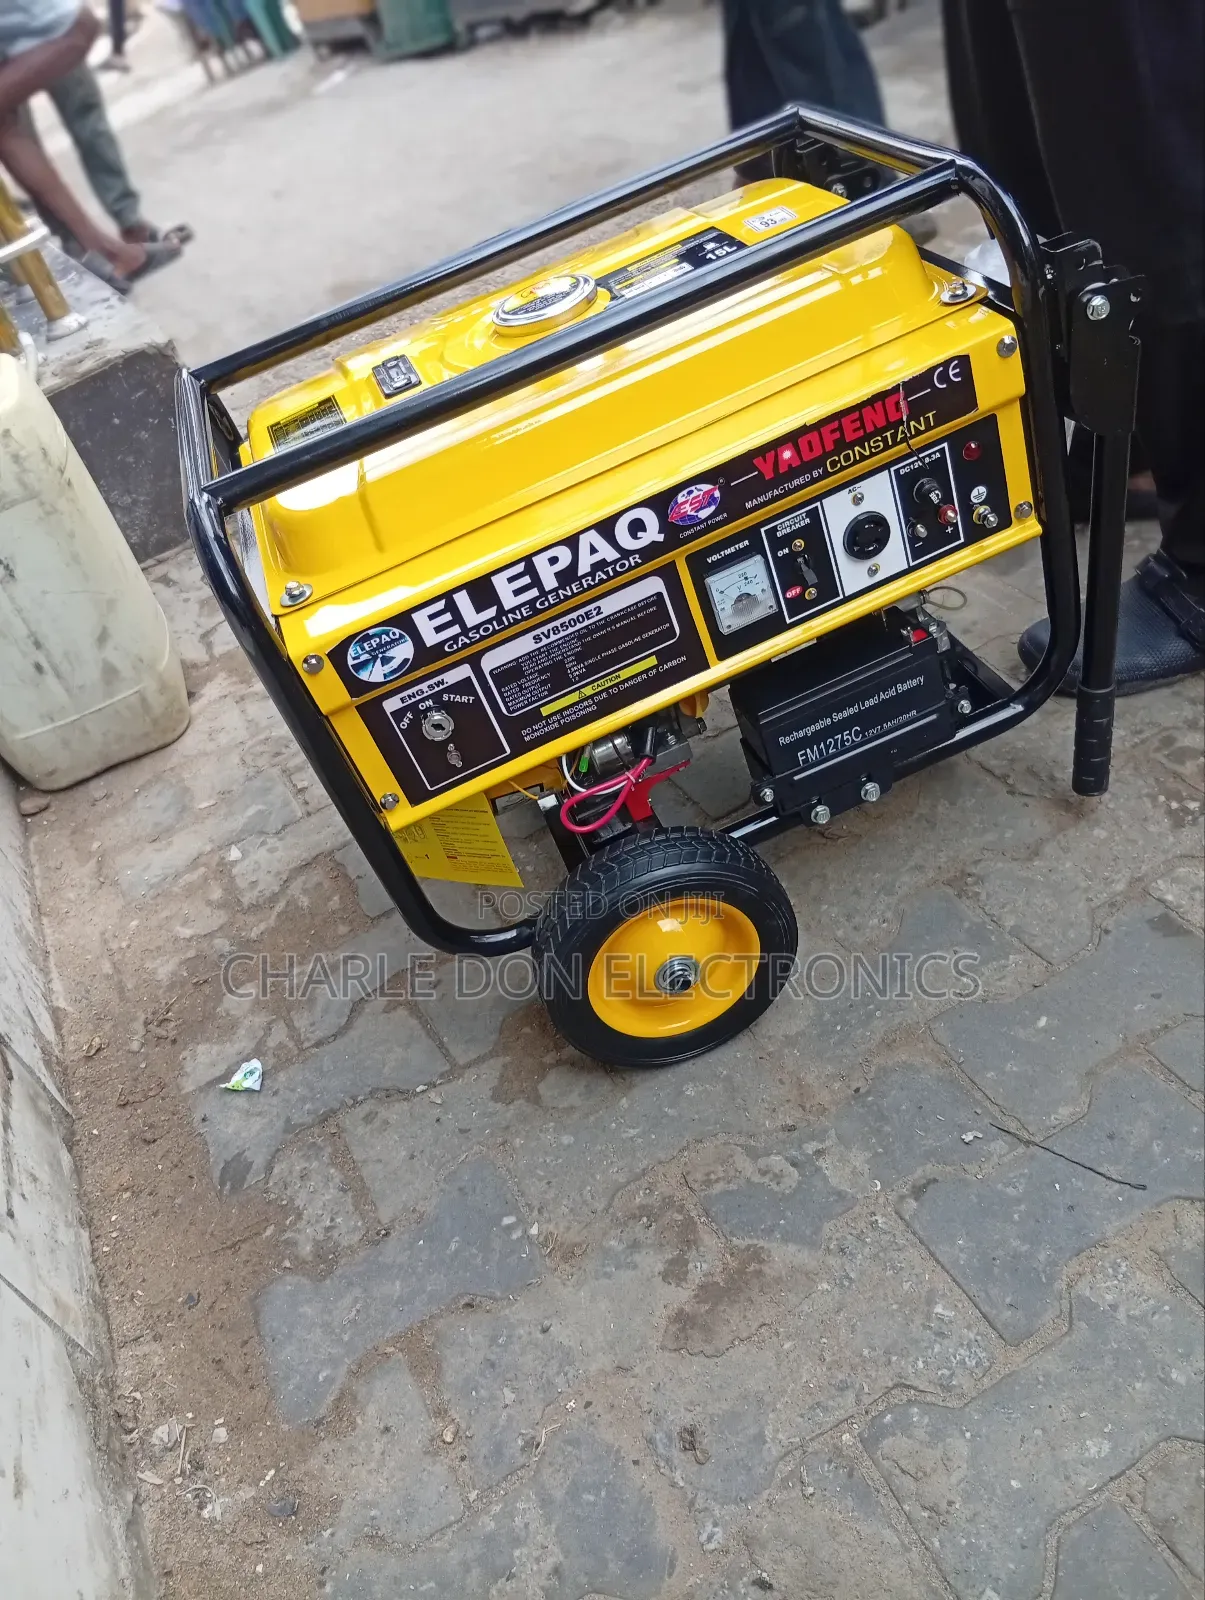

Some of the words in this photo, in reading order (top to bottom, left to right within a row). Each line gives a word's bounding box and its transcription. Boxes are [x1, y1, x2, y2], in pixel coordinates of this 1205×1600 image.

[706, 245, 737, 260] 15L
[745, 474, 812, 510] MANUFACTURED
[812, 467, 824, 478] BY
[826, 410, 937, 473] CONSTANT
[680, 523, 707, 539] CONSTANT
[708, 512, 728, 526] POWER
[776, 513, 806, 531] CIRCUIT
[776, 518, 810, 538] BREAKER
[706, 540, 750, 564] VOLTMETER
[778, 548, 789, 557] ON
[411, 507, 664, 648] ELEPAQ
[444, 604, 532, 653] GASOLINE
[536, 554, 642, 612] GENERATOR
[786, 588, 802, 598] OFF
[532, 606, 604, 644] SV8500E2
[350, 630, 400, 658] ELEPAQ
[506, 692, 522, 702] RATED
[522, 684, 541, 696] OUTPUT
[618, 636, 642, 650] GASOLINE
[642, 622, 670, 638] GENERATOR
[400, 678, 448, 705] ENG.SW.
[501, 682, 518, 692] RATED
[504, 687, 520, 698] RATED
[522, 672, 551, 688] FREQUENCY
[508, 694, 532, 706] MAXIMUM
[532, 684, 552, 696] OUTPUT
[522, 726, 532, 736] DO
[532, 718, 548, 732] NOT
[548, 712, 562, 726] USE
[563, 698, 592, 720] INDOORS
[594, 692, 608, 703] DUE
[608, 686, 618, 696] TO
[619, 673, 648, 692] DANGER
[648, 668, 658, 677] OF
[658, 655, 686, 672] CARBON
[591, 674, 621, 692] CAUTION
[418, 699, 434, 710] ON
[442, 694, 474, 704] START
[510, 700, 528, 712] POWER
[528, 690, 549, 703] FACTOR
[778, 717, 832, 746] Rechargeable
[832, 704, 859, 722] Sealed
[859, 694, 878, 710] Lead
[879, 685, 896, 702] Acid
[896, 674, 924, 694] Battery
[400, 711, 414, 730] OFF
[524, 721, 560, 742] MONOXIDE
[560, 704, 598, 726] POISONING
[797, 726, 862, 766] FM1275C
